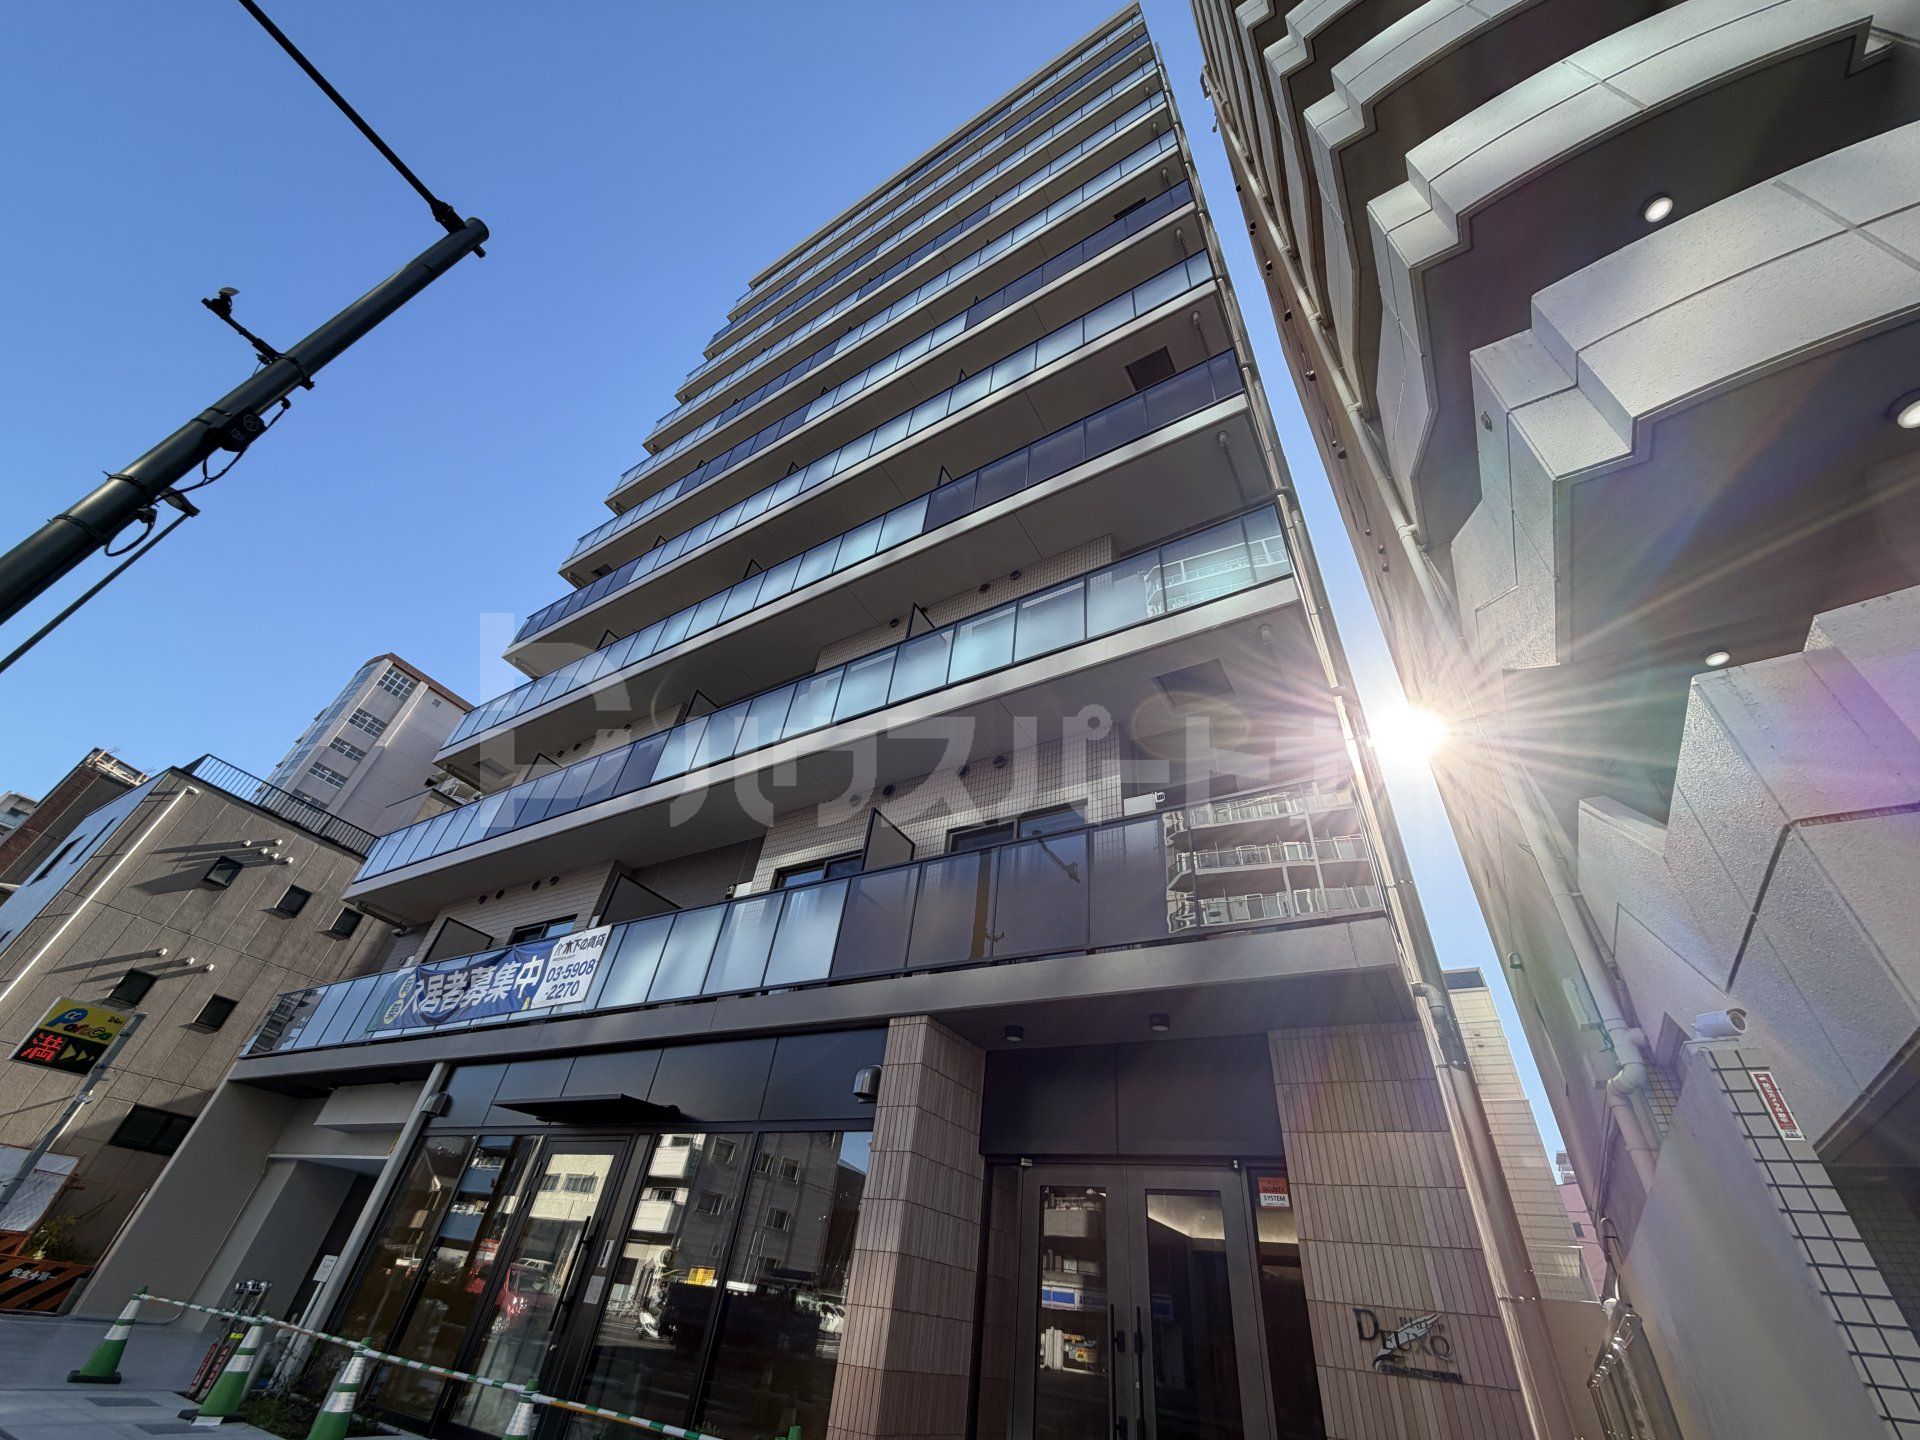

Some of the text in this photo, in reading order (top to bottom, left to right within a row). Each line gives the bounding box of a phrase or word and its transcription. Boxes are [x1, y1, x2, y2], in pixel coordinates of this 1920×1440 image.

[401, 955, 544, 1015] 入居者募集中
[546, 959, 596, 983] 03-5908
